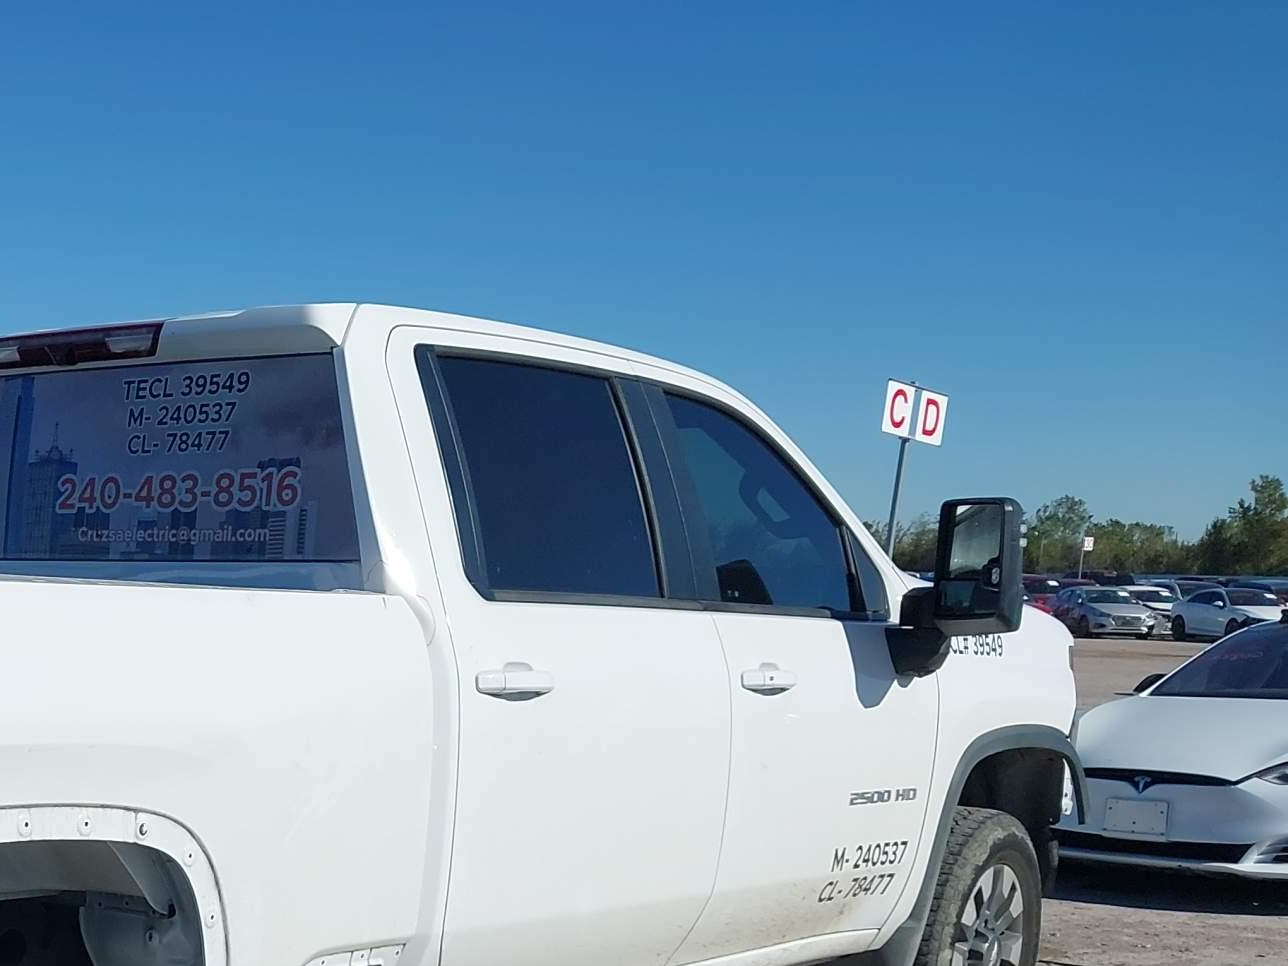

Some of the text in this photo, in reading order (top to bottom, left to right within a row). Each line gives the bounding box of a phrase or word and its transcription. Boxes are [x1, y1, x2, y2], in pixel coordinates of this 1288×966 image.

[123, 371, 250, 401] TECL 39549
[127, 401, 237, 428] M- 240537
[890, 388, 940, 436] C D
[127, 430, 230, 455] CL- 78477
[57, 469, 299, 512] 240-483-8516
[78, 525, 269, 544] Cruzsaelectric@gmail.com
[973, 634, 1003, 656] 39549
[849, 788, 917, 806] 2500 HD
[831, 841, 909, 873] M- 240537
[817, 873, 896, 903] CL- 78477
